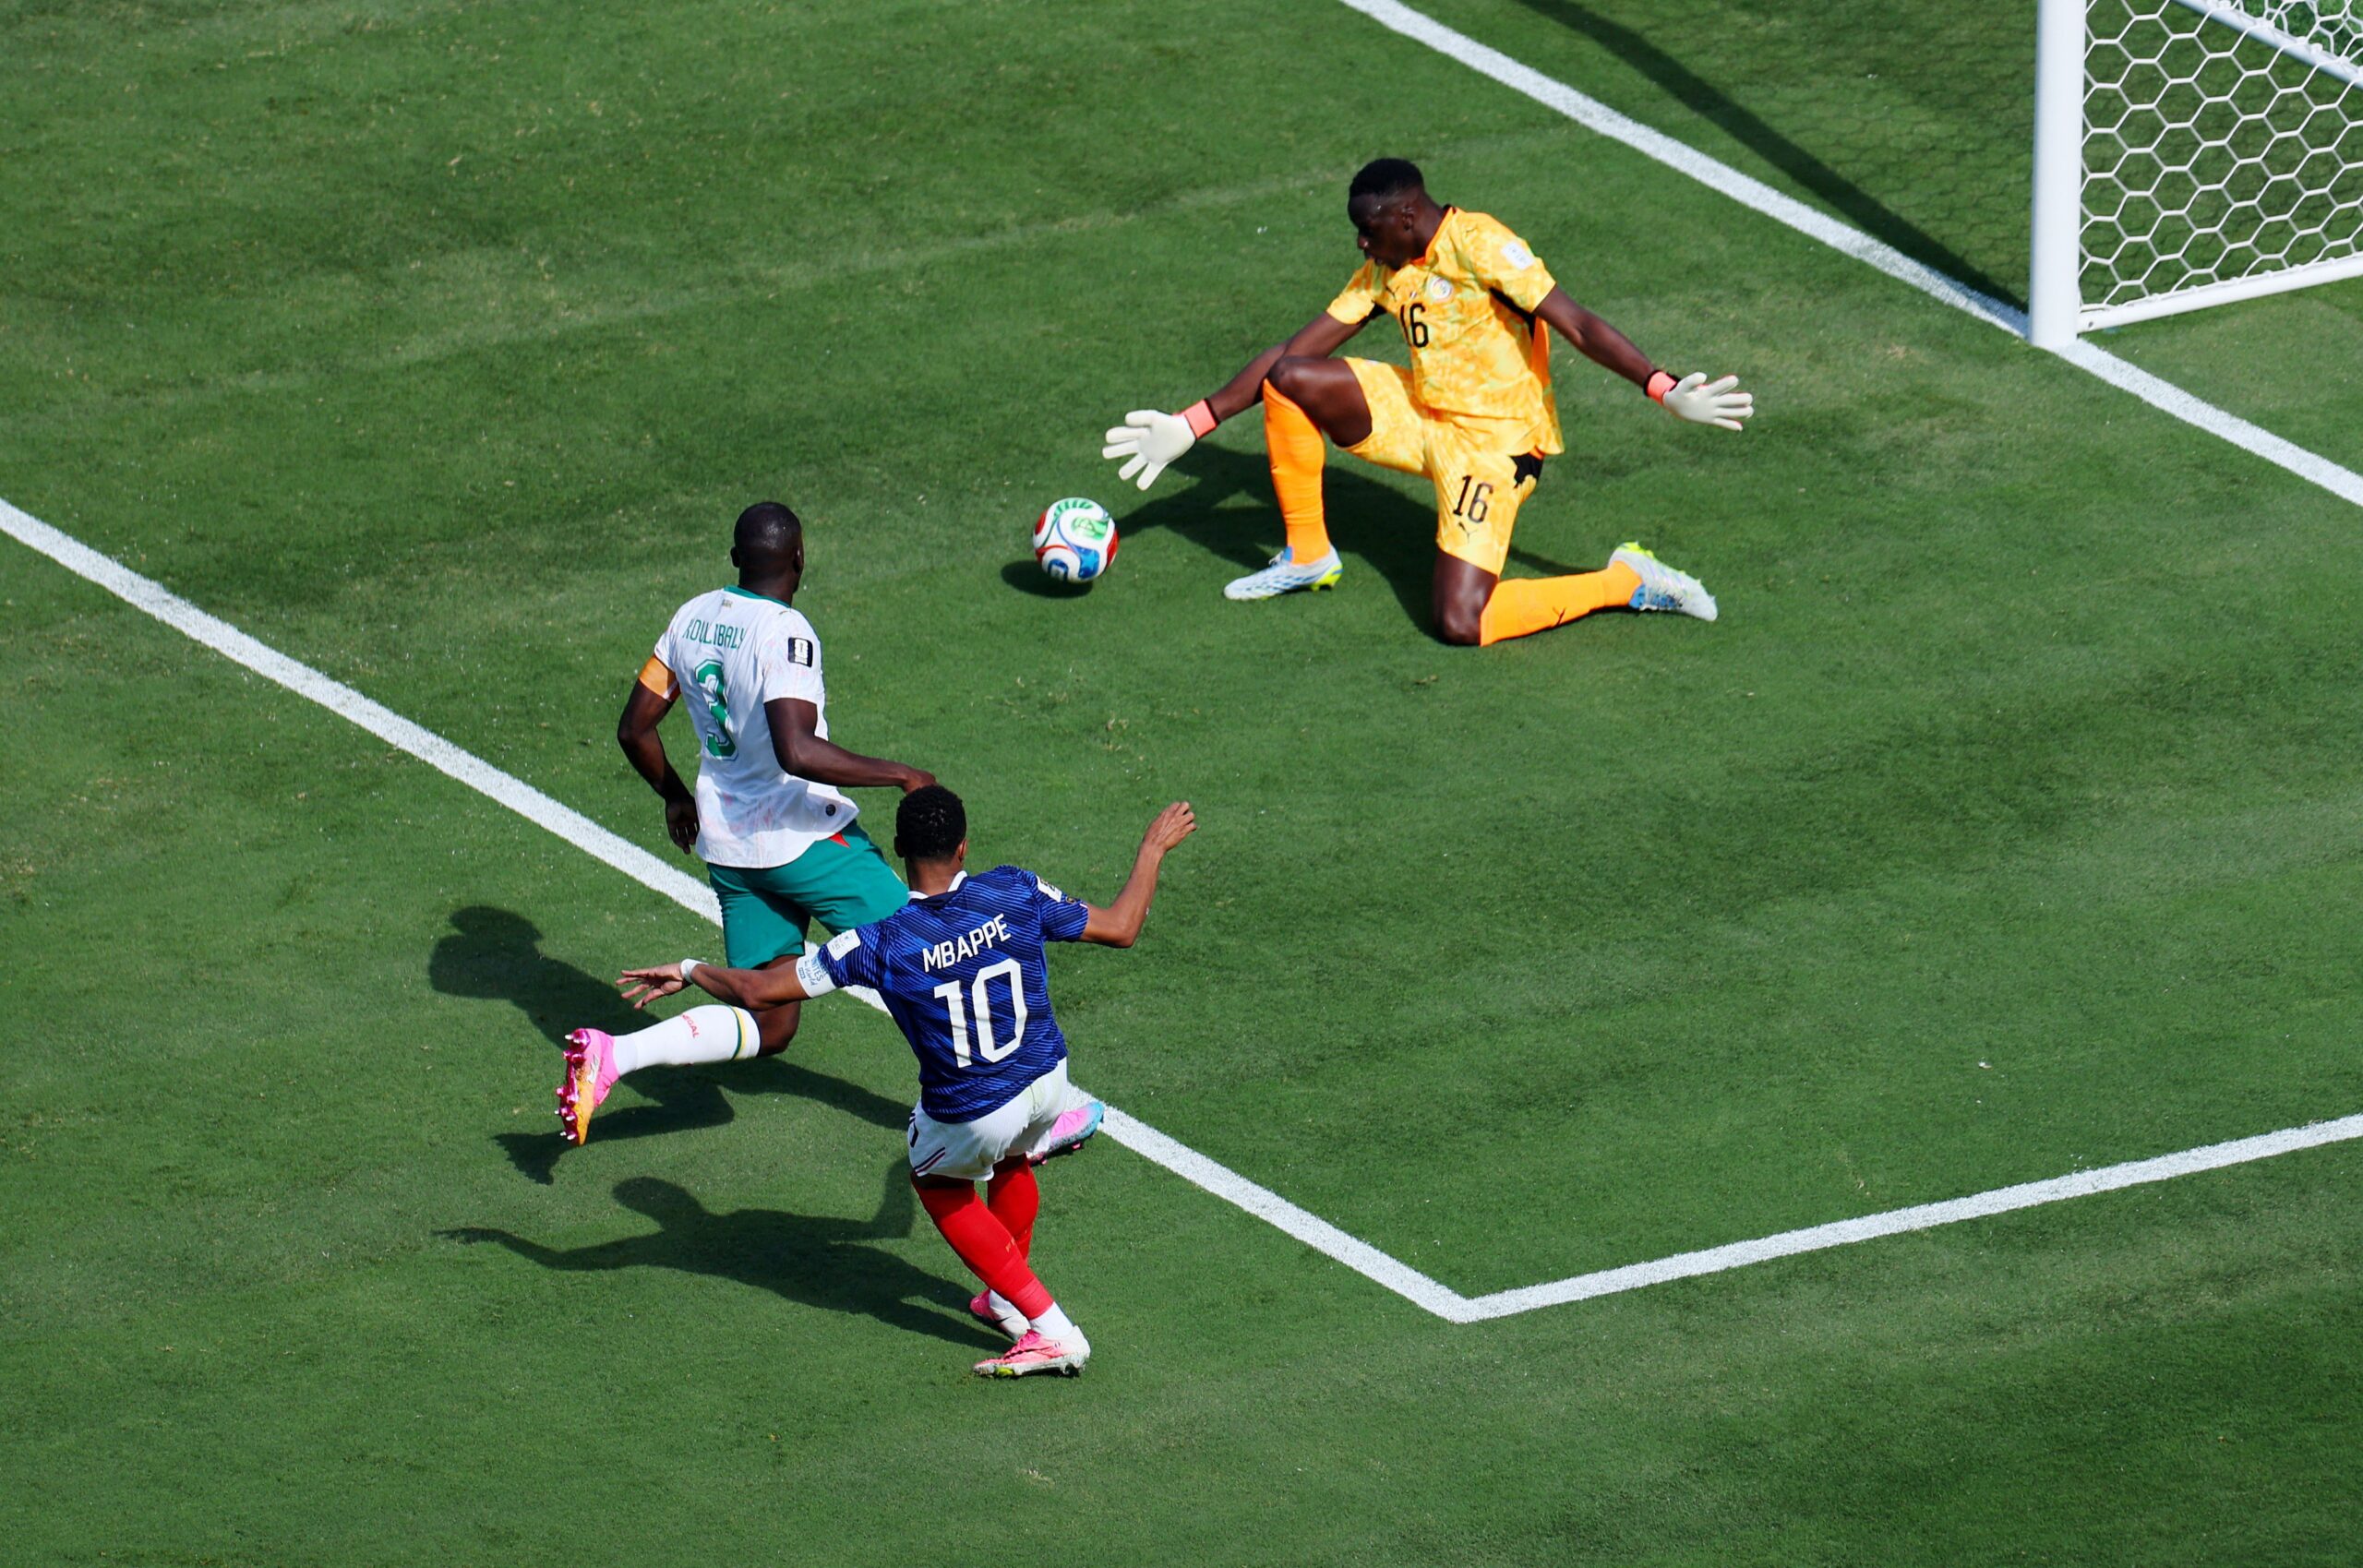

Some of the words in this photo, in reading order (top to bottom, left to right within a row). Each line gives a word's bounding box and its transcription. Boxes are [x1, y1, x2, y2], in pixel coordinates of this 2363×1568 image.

[1400, 303, 1430, 349] 16
[1453, 475, 1493, 523] 16
[682, 618, 745, 650] KOULIBALY
[695, 658, 738, 761] 3
[922, 914, 1012, 973] MBAPPE
[934, 958, 1027, 1069] 10
